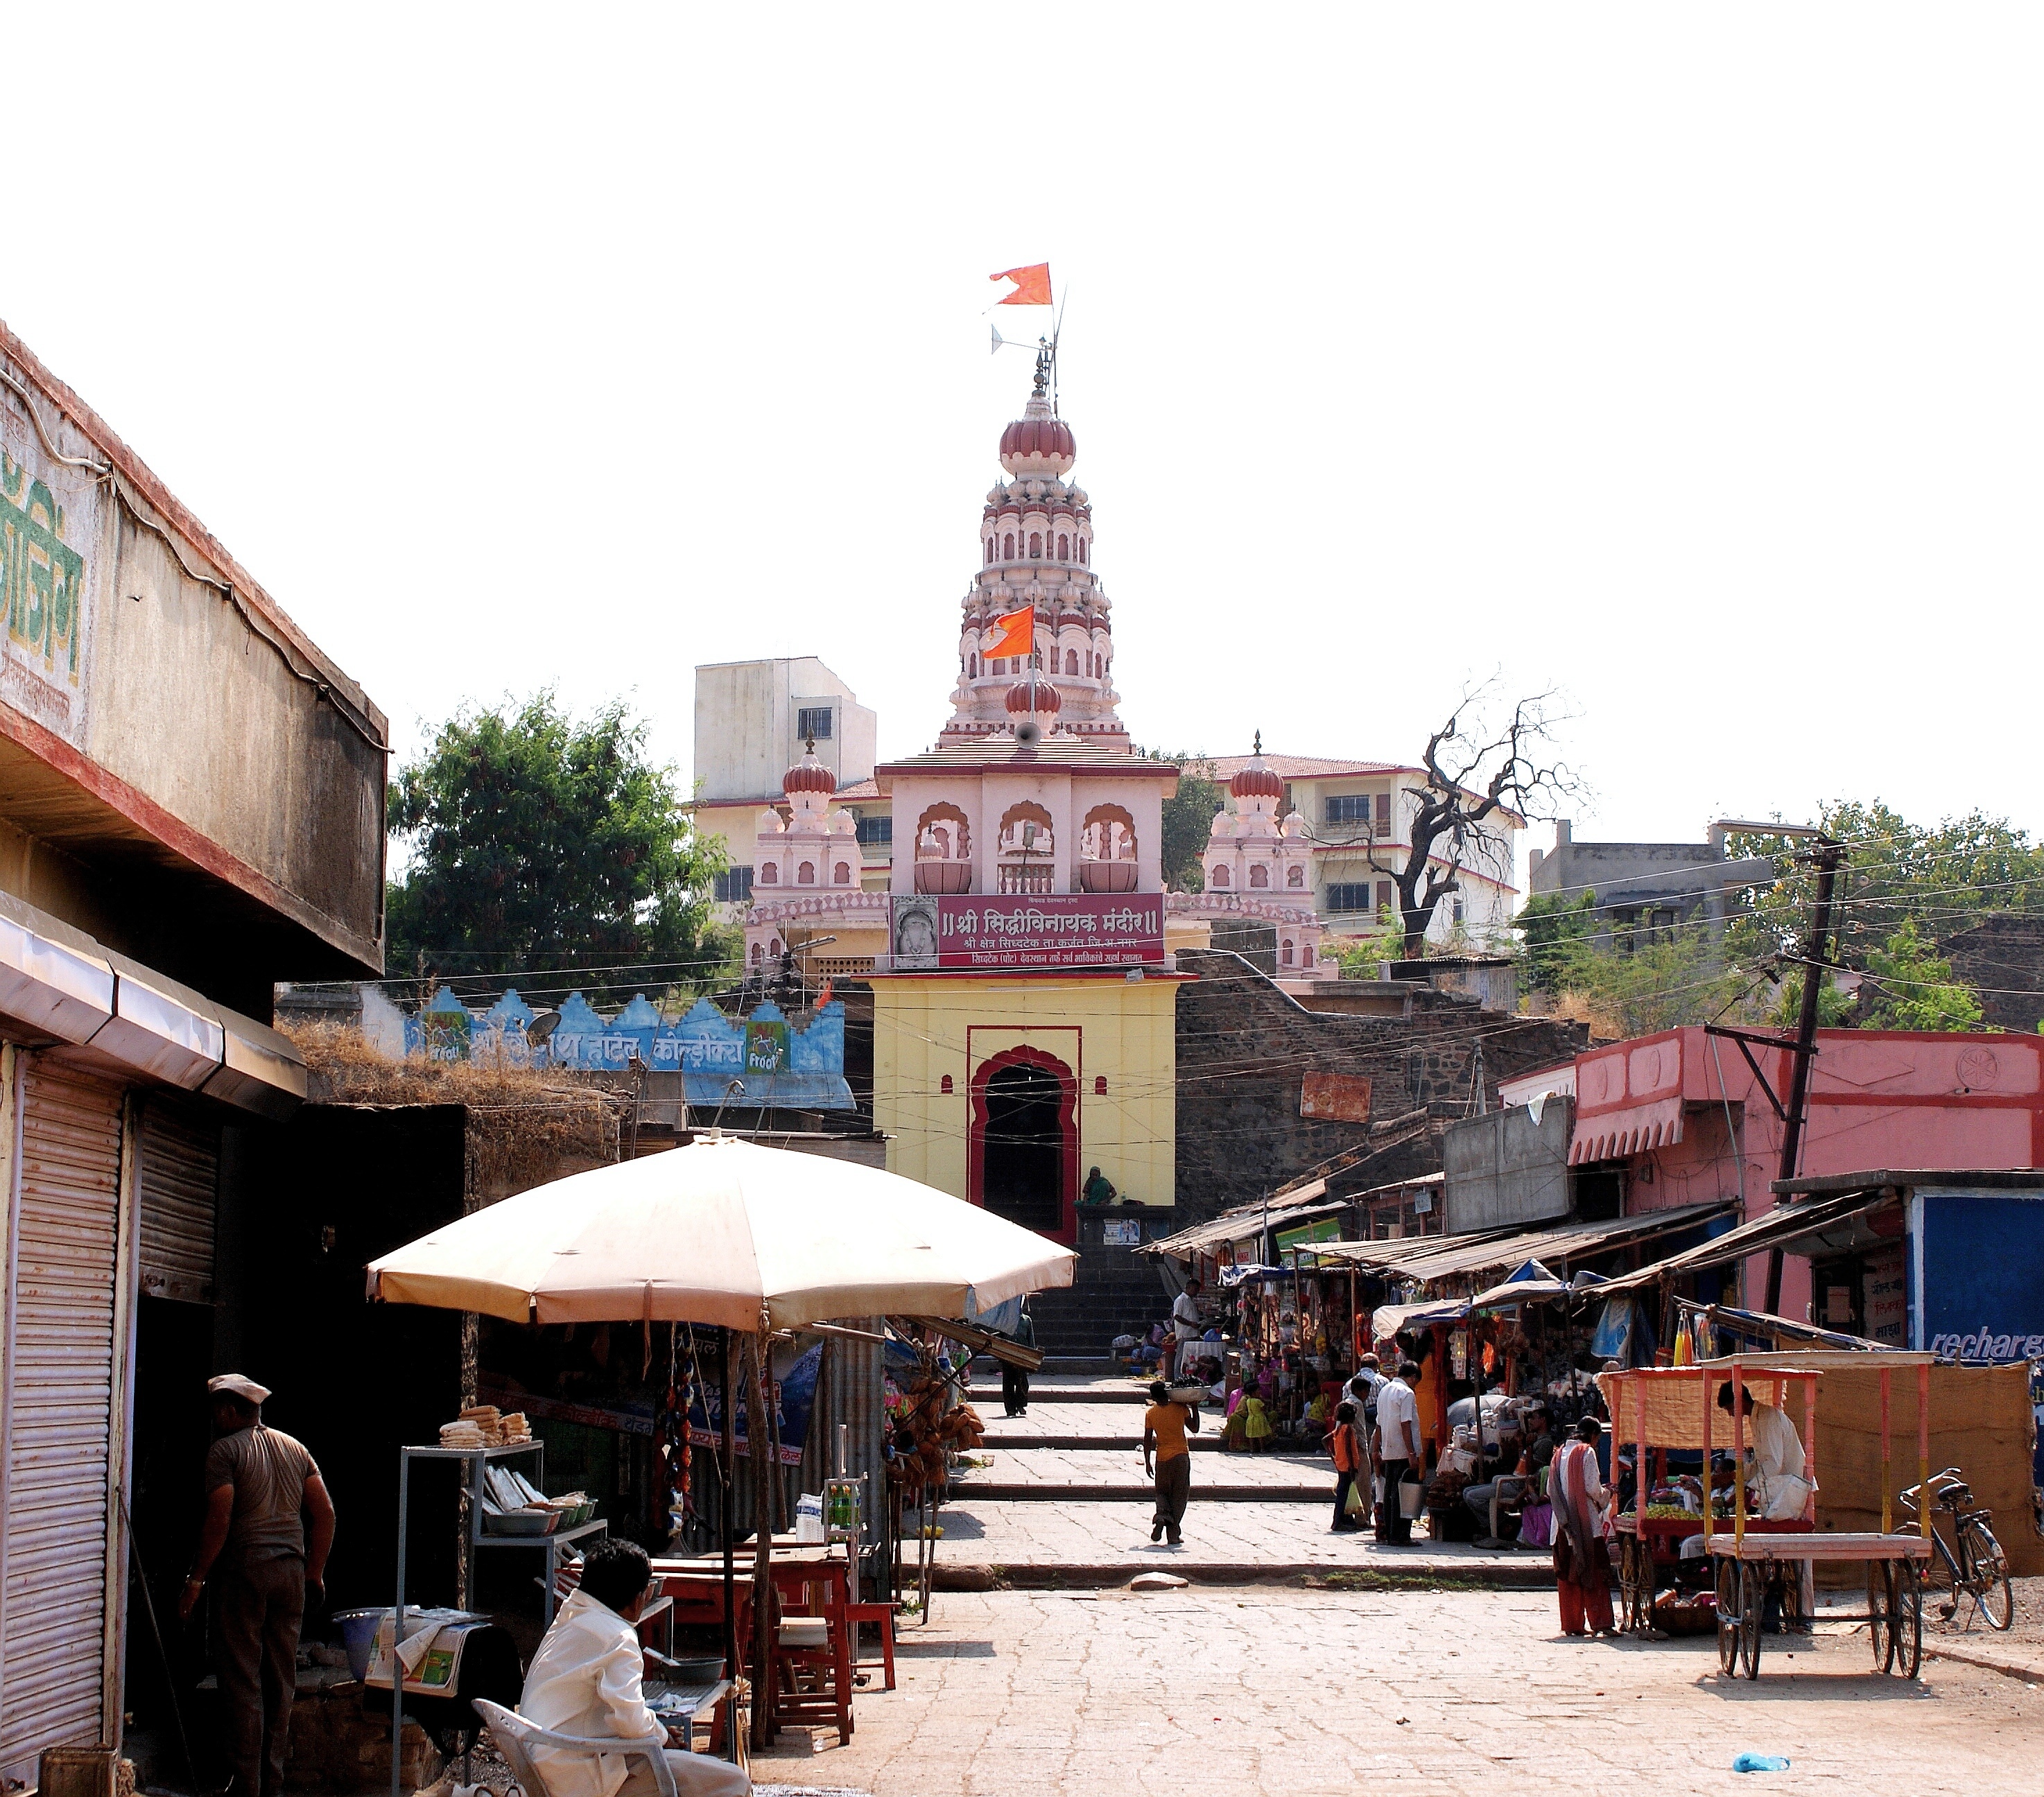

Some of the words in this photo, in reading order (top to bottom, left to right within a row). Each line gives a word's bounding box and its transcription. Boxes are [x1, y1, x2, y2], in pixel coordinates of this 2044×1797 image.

[983, 908, 1098, 935] सिद्धीविनायक
[964, 937, 976, 948] श्री
[980, 936, 996, 948] क्षेत्र
[1020, 952, 1047, 964] देवस्थान
[1062, 951, 1073, 962] सर्व
[1075, 950, 1102, 963] भाविकांचे
[1121, 953, 1143, 962] स्वागत
[1875, 1322, 1900, 1338] माझा
[1930, 1326, 2044, 1358] recharg
